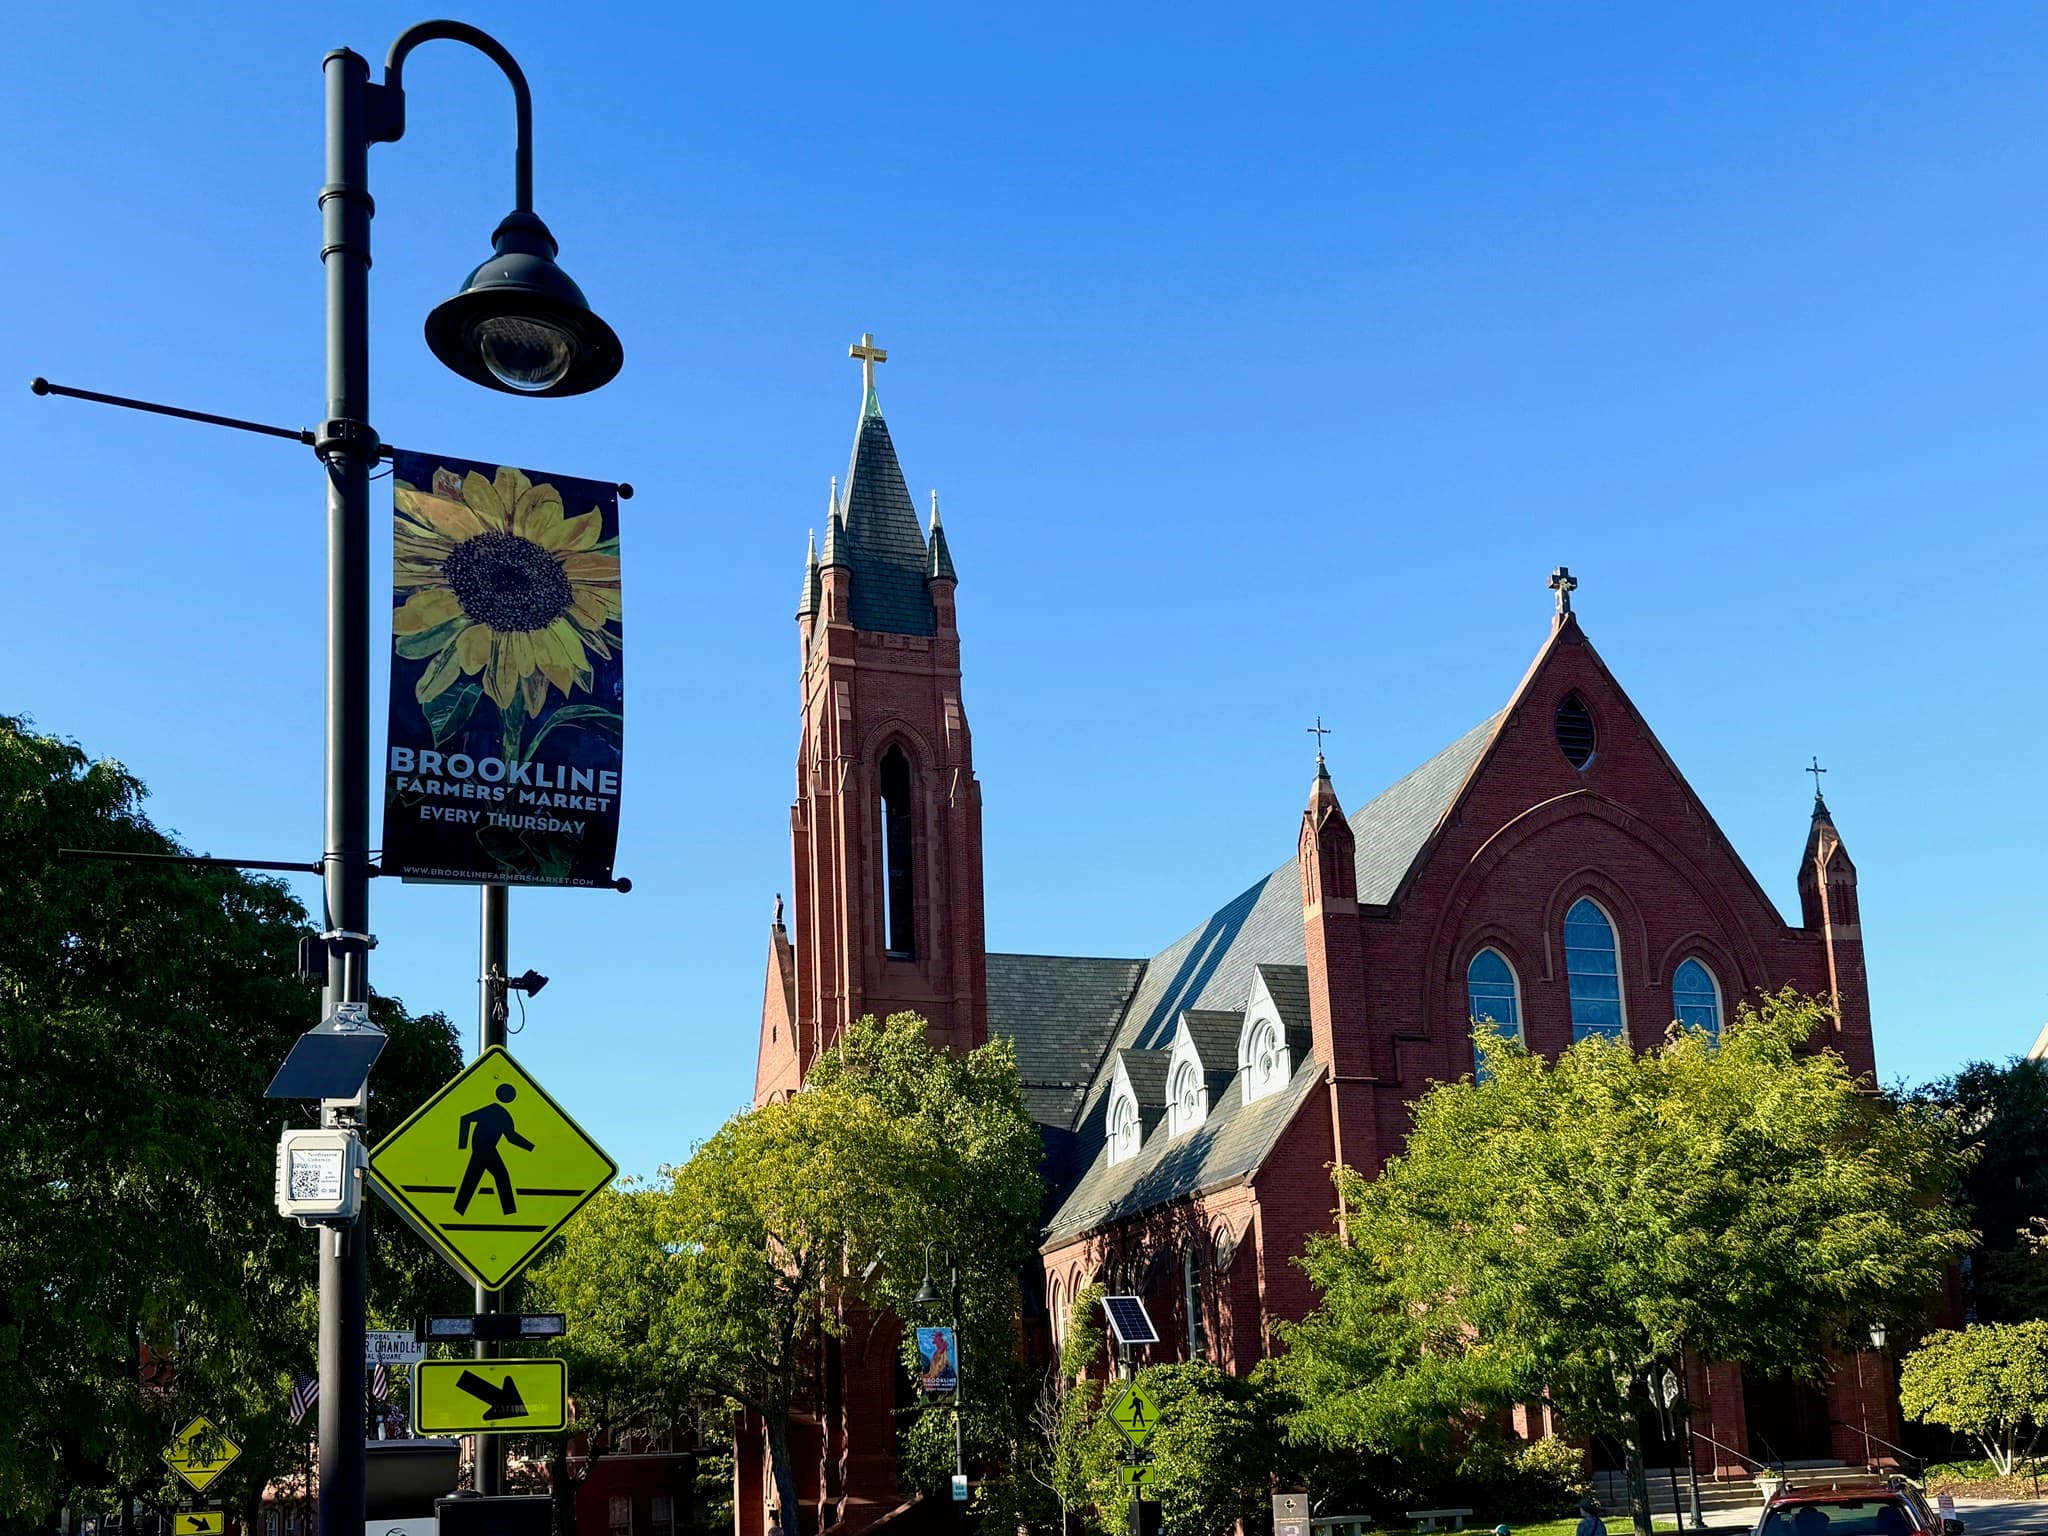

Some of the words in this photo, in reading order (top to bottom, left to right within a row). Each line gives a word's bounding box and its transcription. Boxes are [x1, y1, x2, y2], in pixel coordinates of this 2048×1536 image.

[391, 746, 618, 795] BROOKLINE
[396, 776, 513, 802] FARMERS'
[519, 790, 610, 813] MARKET
[420, 805, 480, 824] EVERY
[487, 812, 585, 834] THURSDAY
[403, 865, 594, 886] WWW.BROOKLINEFARMERSMARKET.COM
[375, 1341, 422, 1353] CHANDLER
